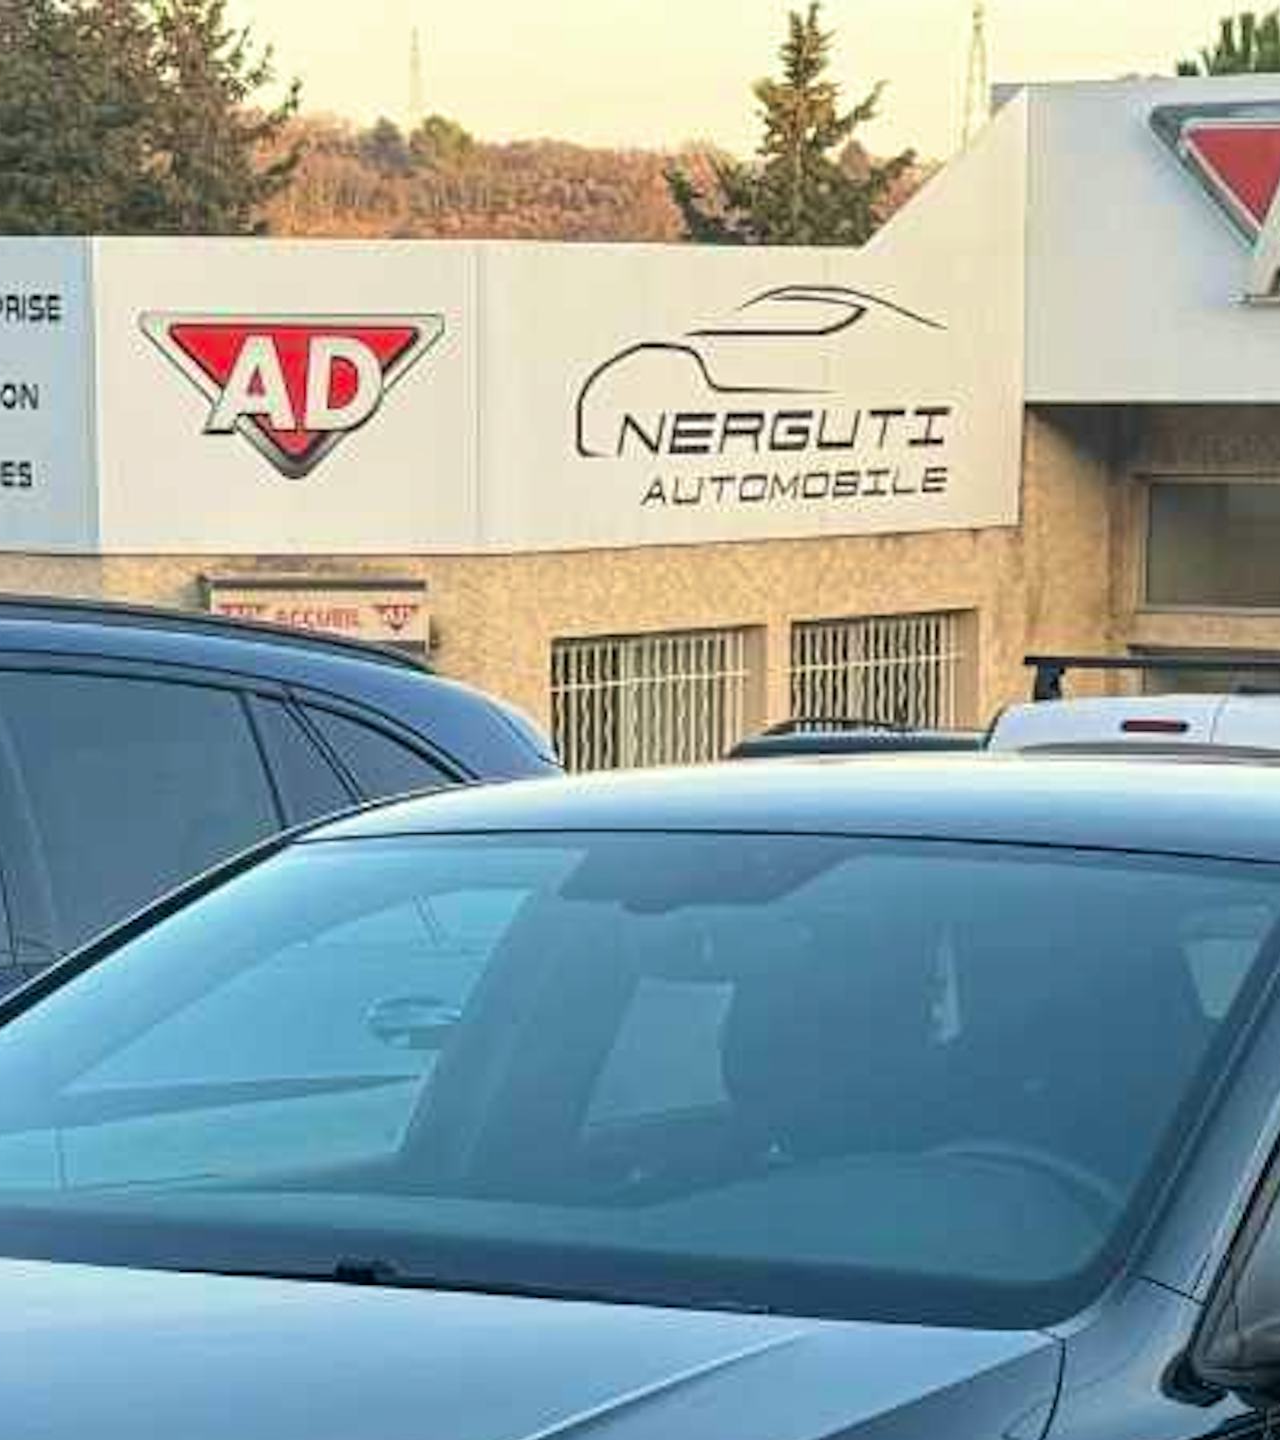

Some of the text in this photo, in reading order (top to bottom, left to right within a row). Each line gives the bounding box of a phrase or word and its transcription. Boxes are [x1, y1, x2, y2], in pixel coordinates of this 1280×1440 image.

[203, 335, 384, 435] AD
[617, 406, 952, 456] NERGUTI
[640, 466, 949, 507] AUTOMOBILE
